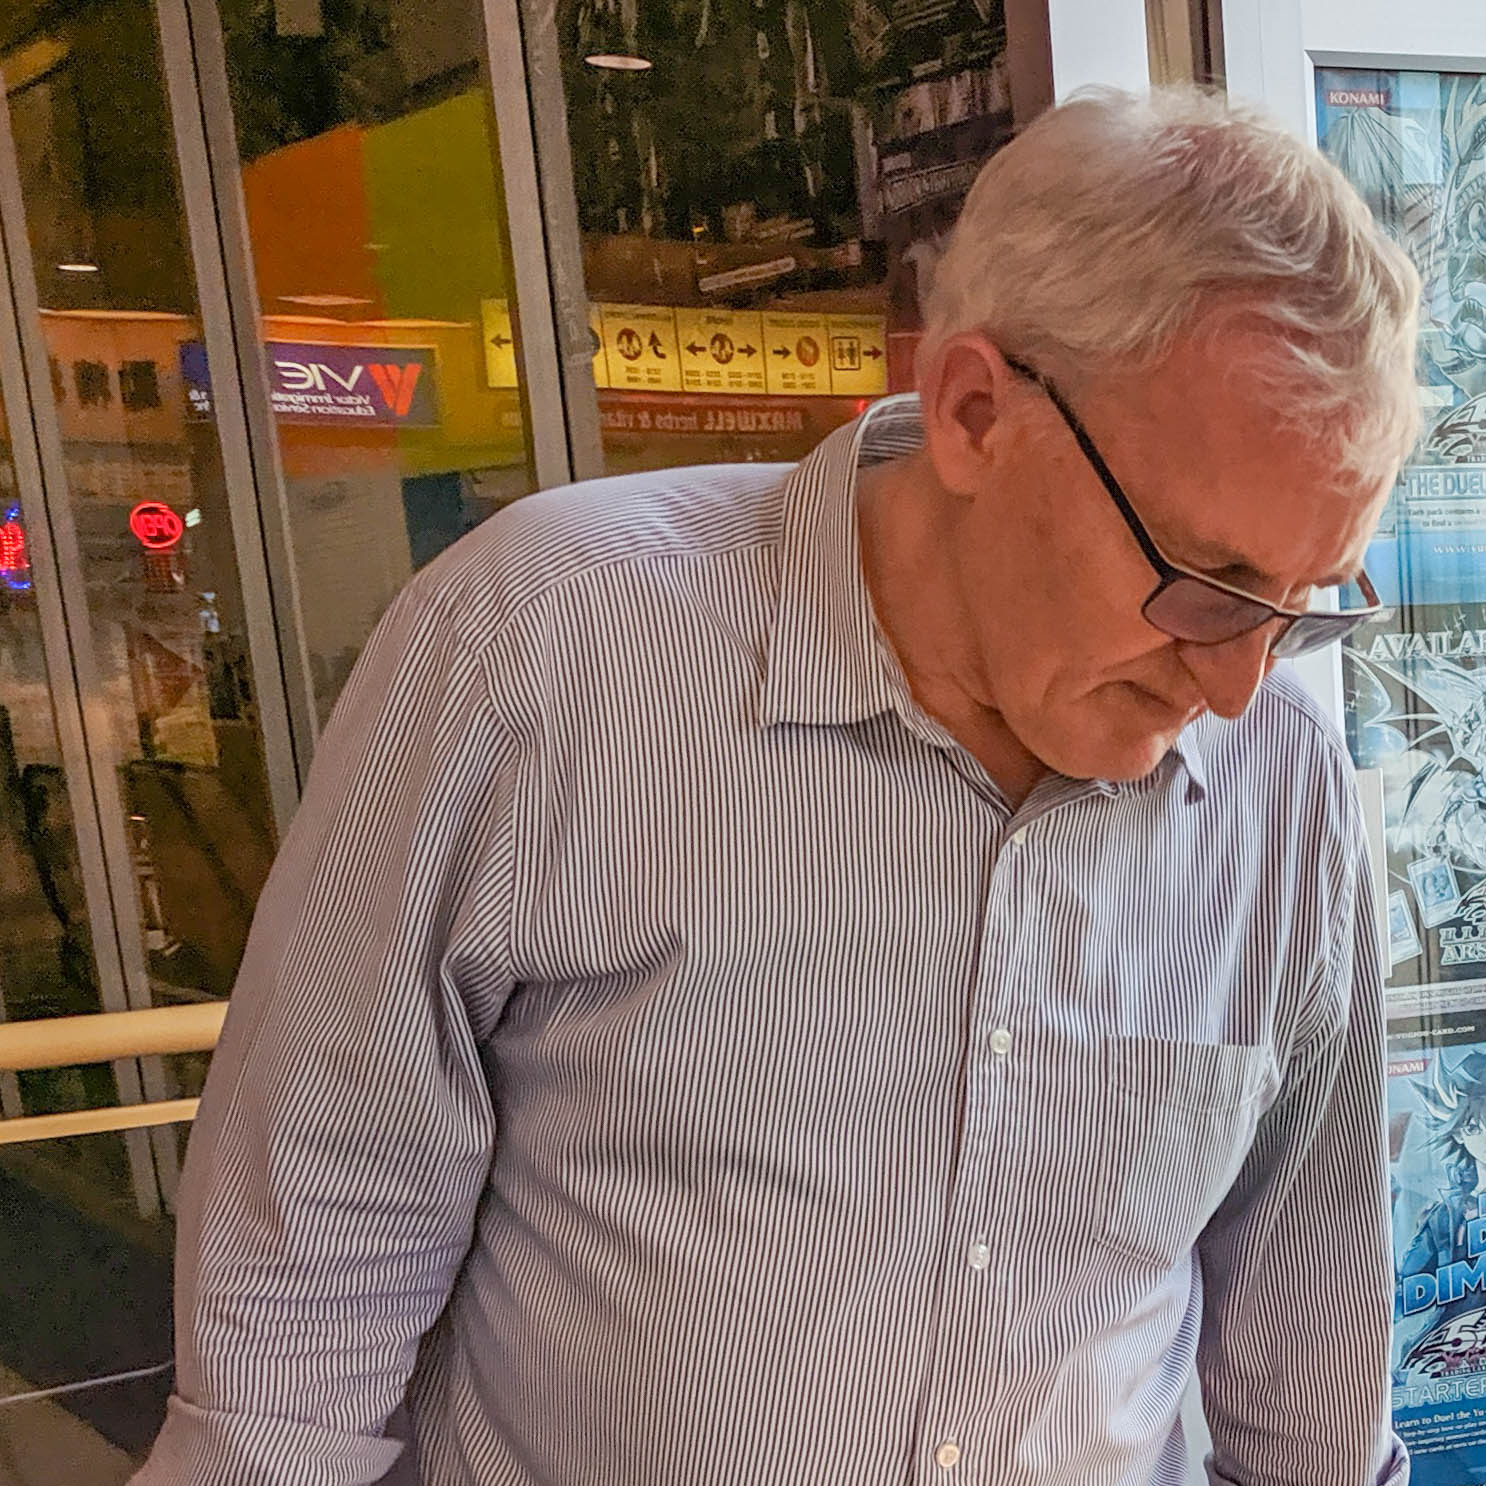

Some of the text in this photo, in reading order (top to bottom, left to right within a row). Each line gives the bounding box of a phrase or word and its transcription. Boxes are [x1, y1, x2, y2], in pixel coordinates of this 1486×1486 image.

[1329, 92, 1384, 105] KONAMI
[1408, 472, 1440, 497] THE
[1389, 1062, 1425, 1075] ONAMI
[1395, 1416, 1420, 1429] Learn
[1433, 1412, 1455, 1423] Duel
[1456, 1410, 1471, 1421] the
